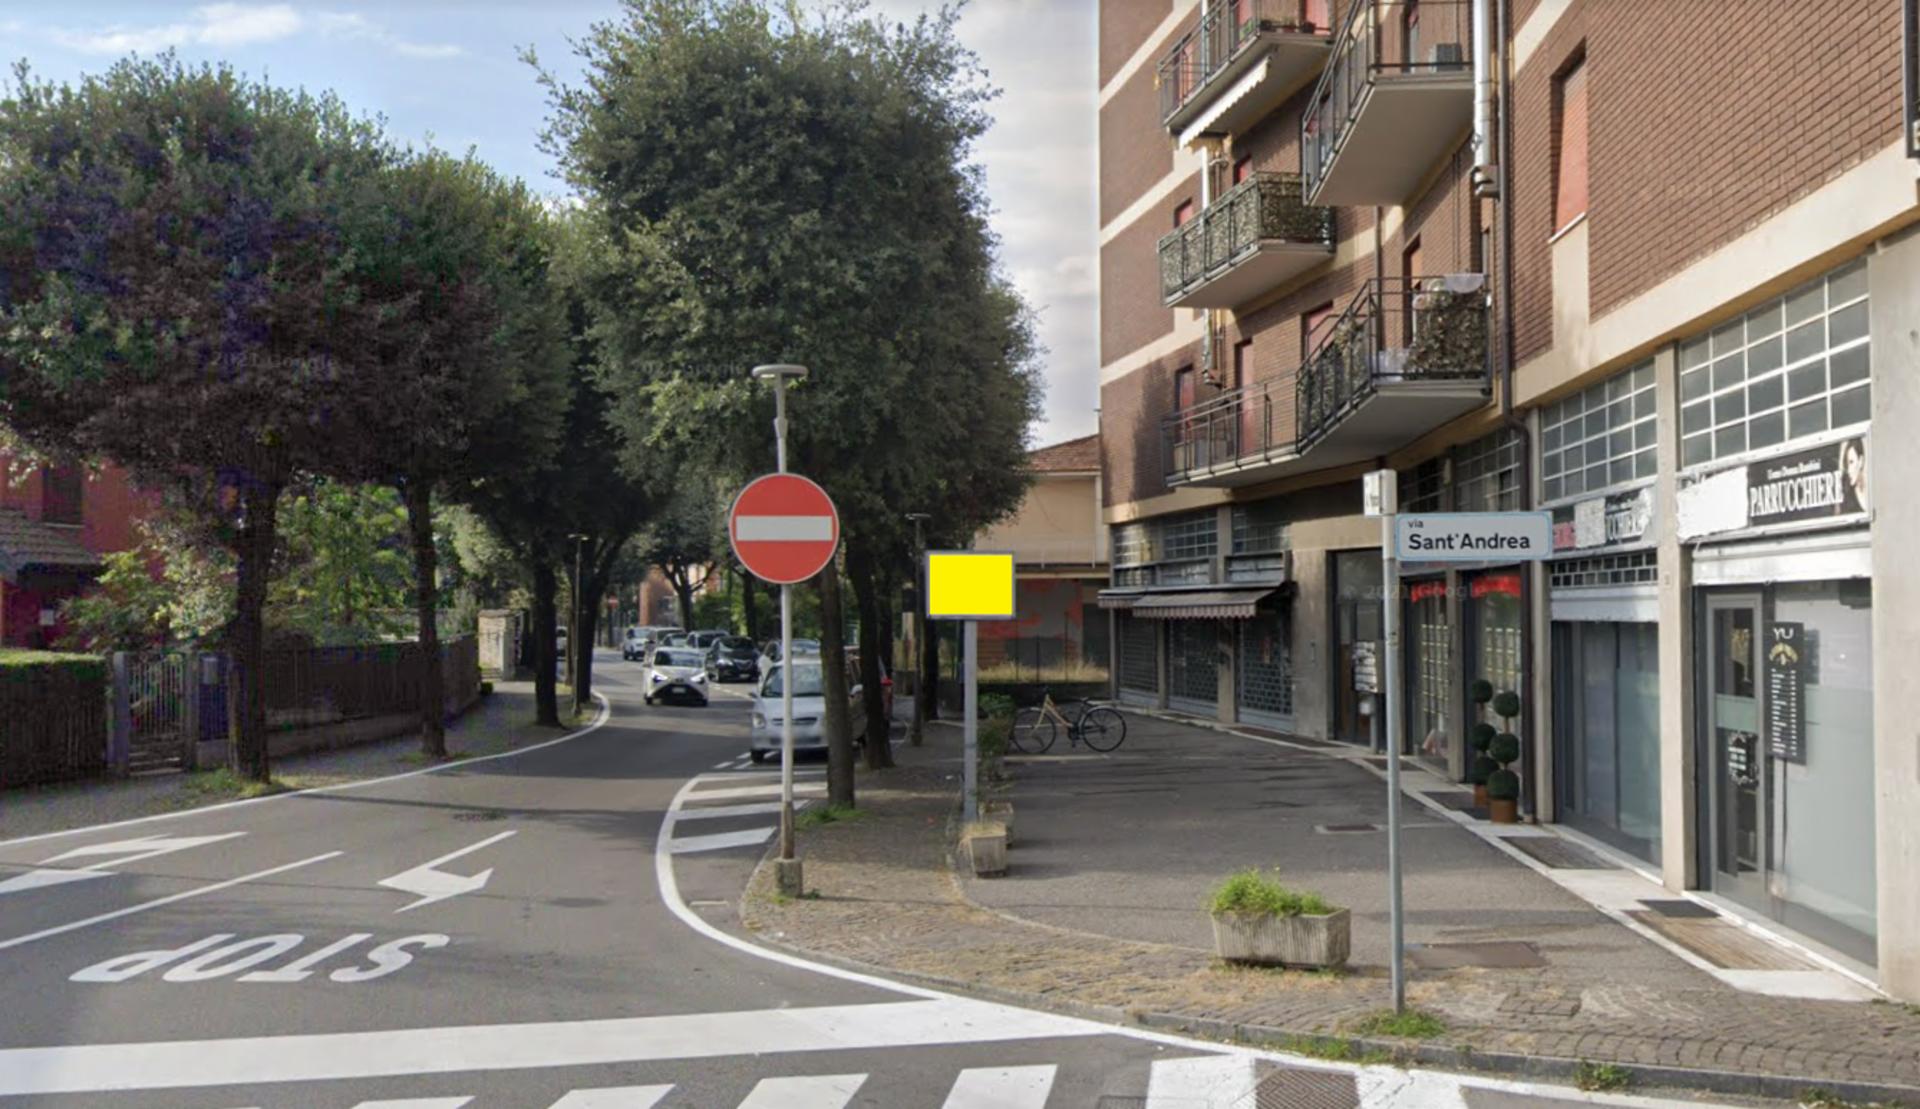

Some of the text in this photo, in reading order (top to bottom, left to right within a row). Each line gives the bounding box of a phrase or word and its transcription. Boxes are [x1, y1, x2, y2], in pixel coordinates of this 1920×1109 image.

[1750, 470, 1844, 517] PARRUCCHIERE
[1407, 519, 1424, 529] via
[1408, 532, 1531, 551] Sant'Andrea
[1772, 626, 1794, 640] YU
[68, 933, 451, 982] STOP
